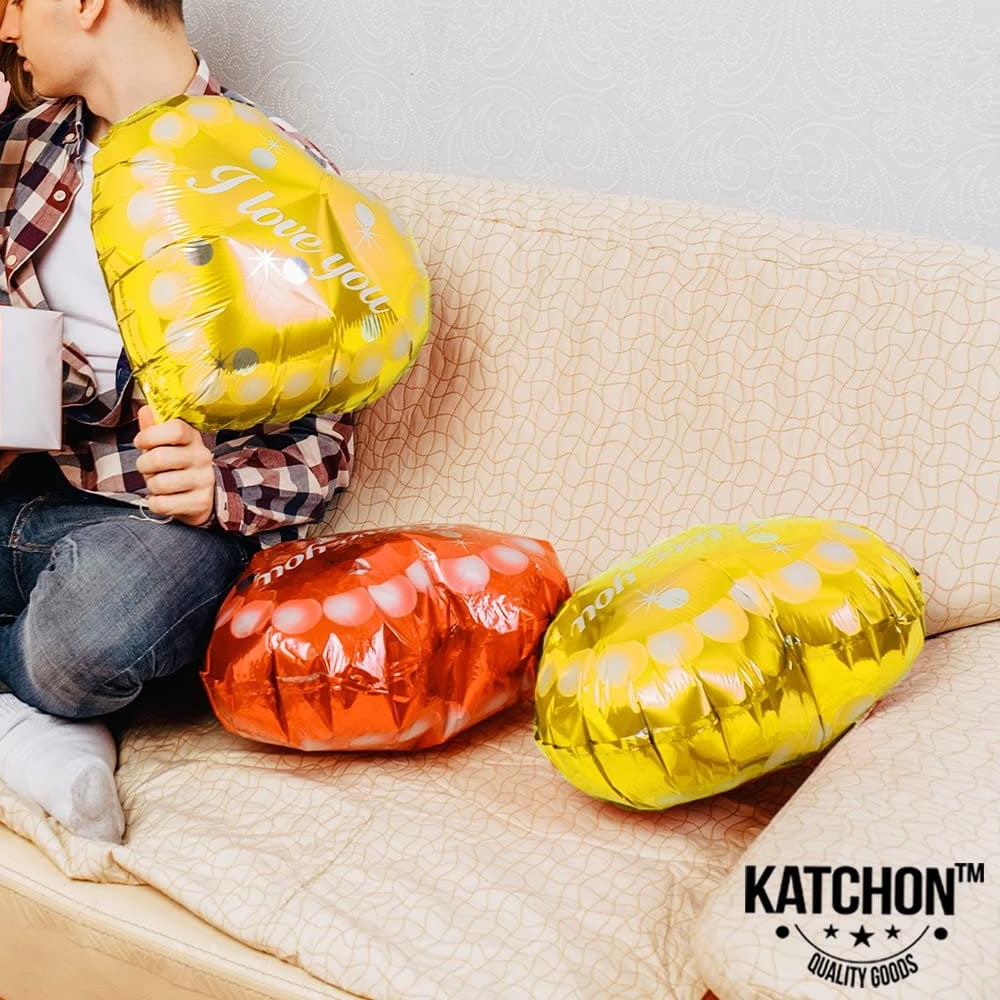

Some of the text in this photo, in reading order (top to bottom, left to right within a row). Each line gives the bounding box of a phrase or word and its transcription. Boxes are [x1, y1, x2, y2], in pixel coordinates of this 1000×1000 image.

[186, 165, 391, 315] I love you
